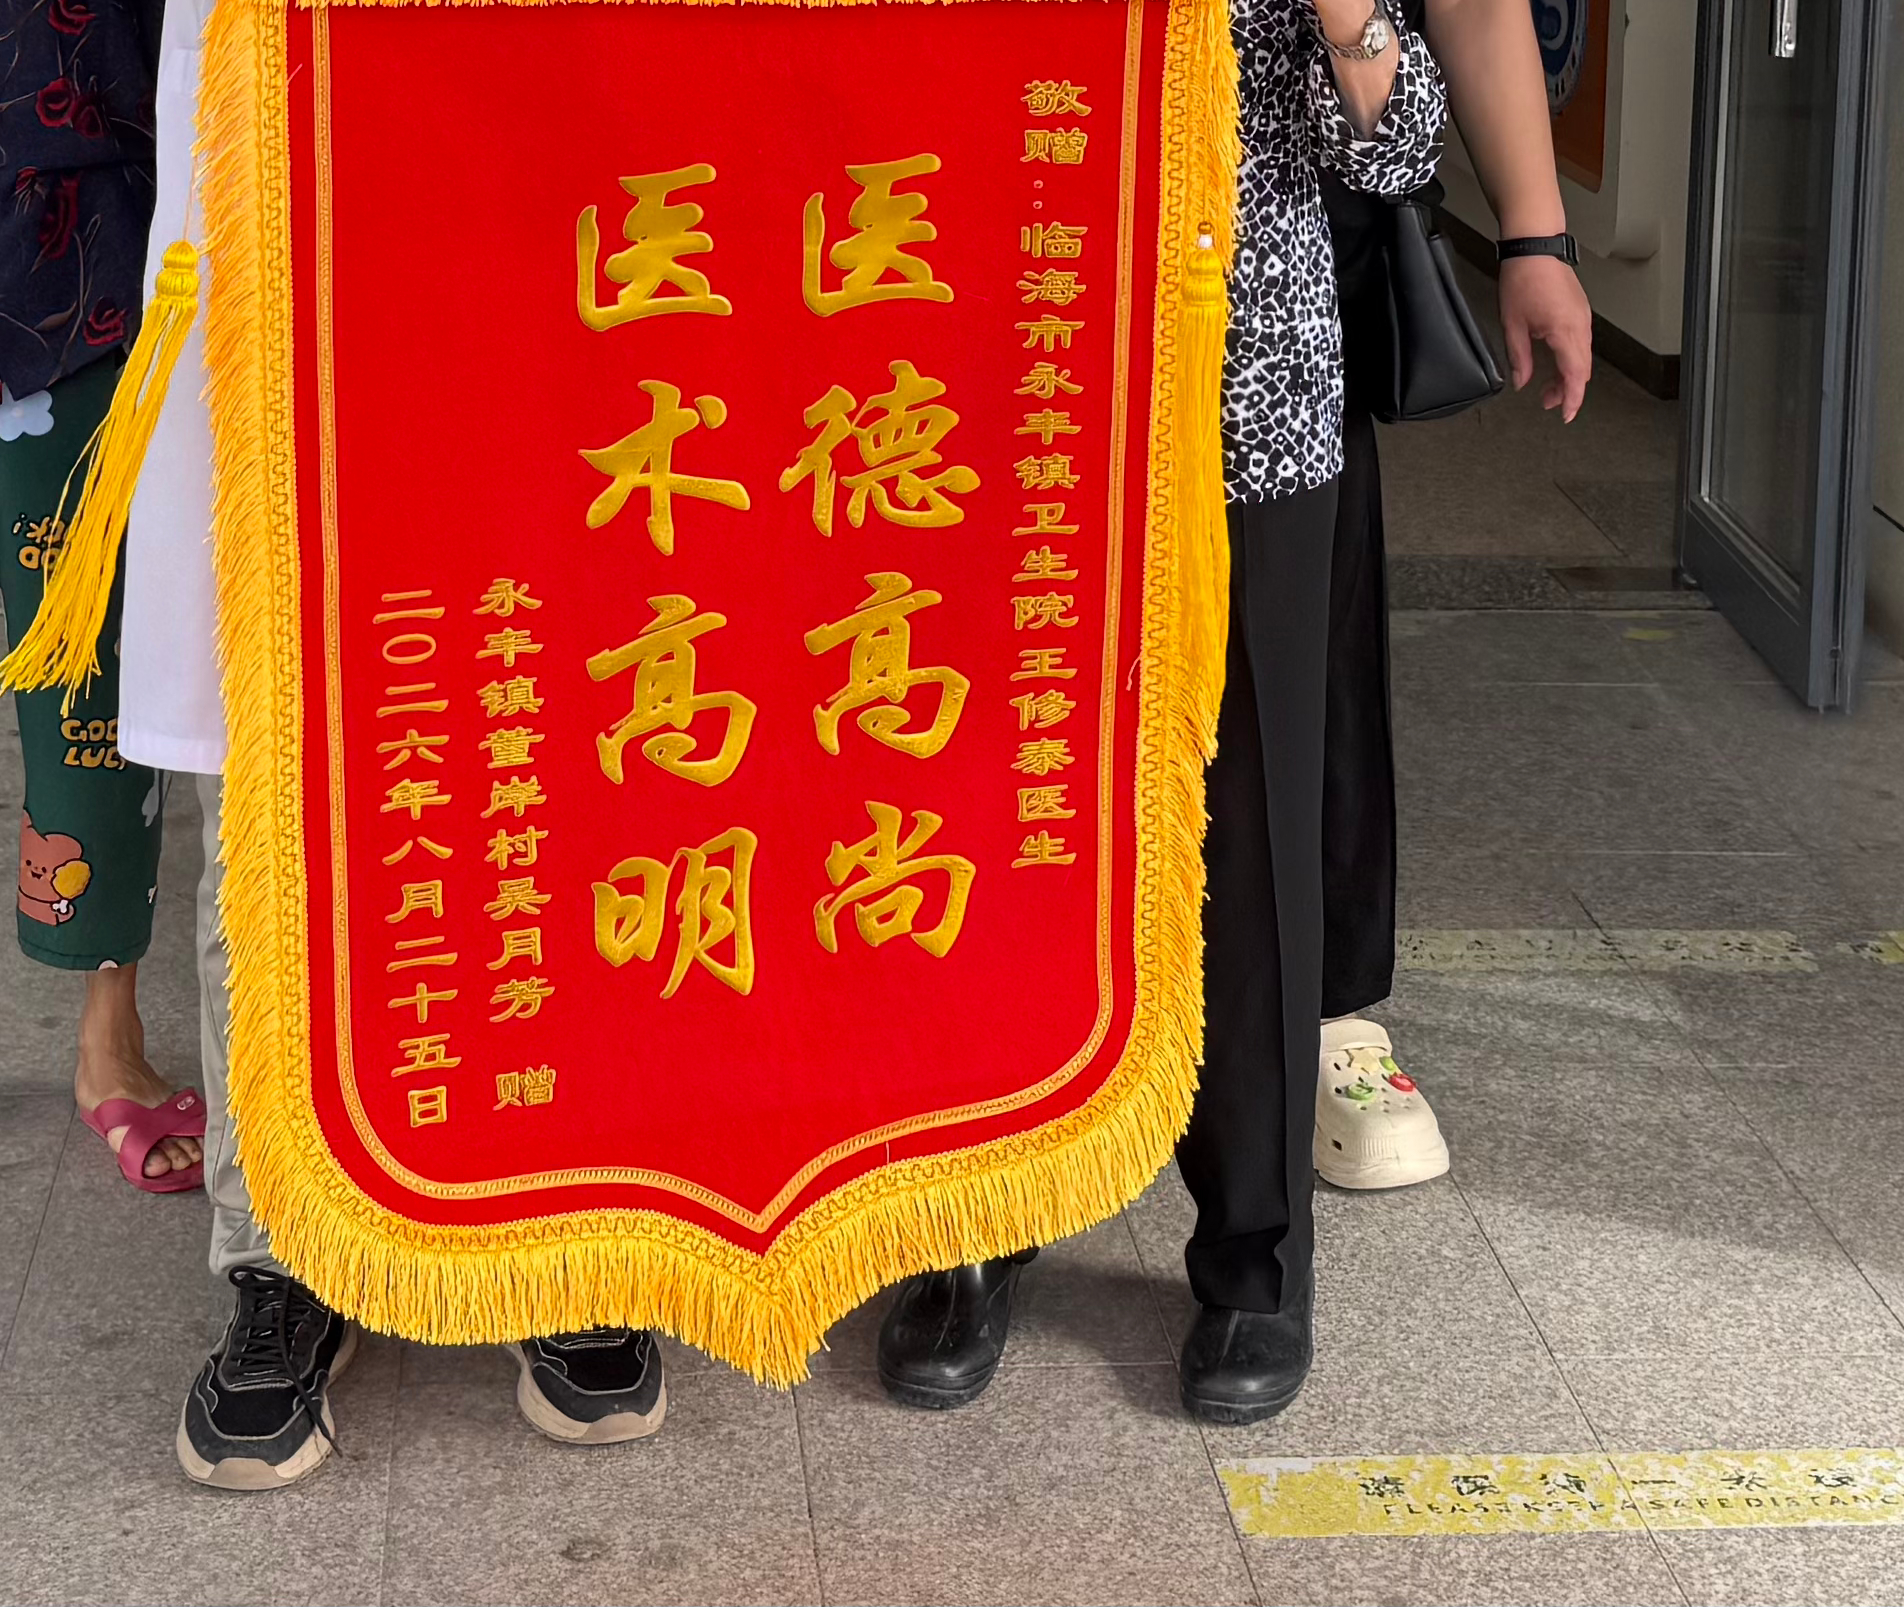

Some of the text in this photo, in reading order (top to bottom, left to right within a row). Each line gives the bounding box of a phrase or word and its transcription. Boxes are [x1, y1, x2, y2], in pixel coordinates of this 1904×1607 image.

[576, 163, 758, 1000] 医术高明
[779, 153, 981, 959] 医德高尚
[495, 1065, 557, 1112] 赠
